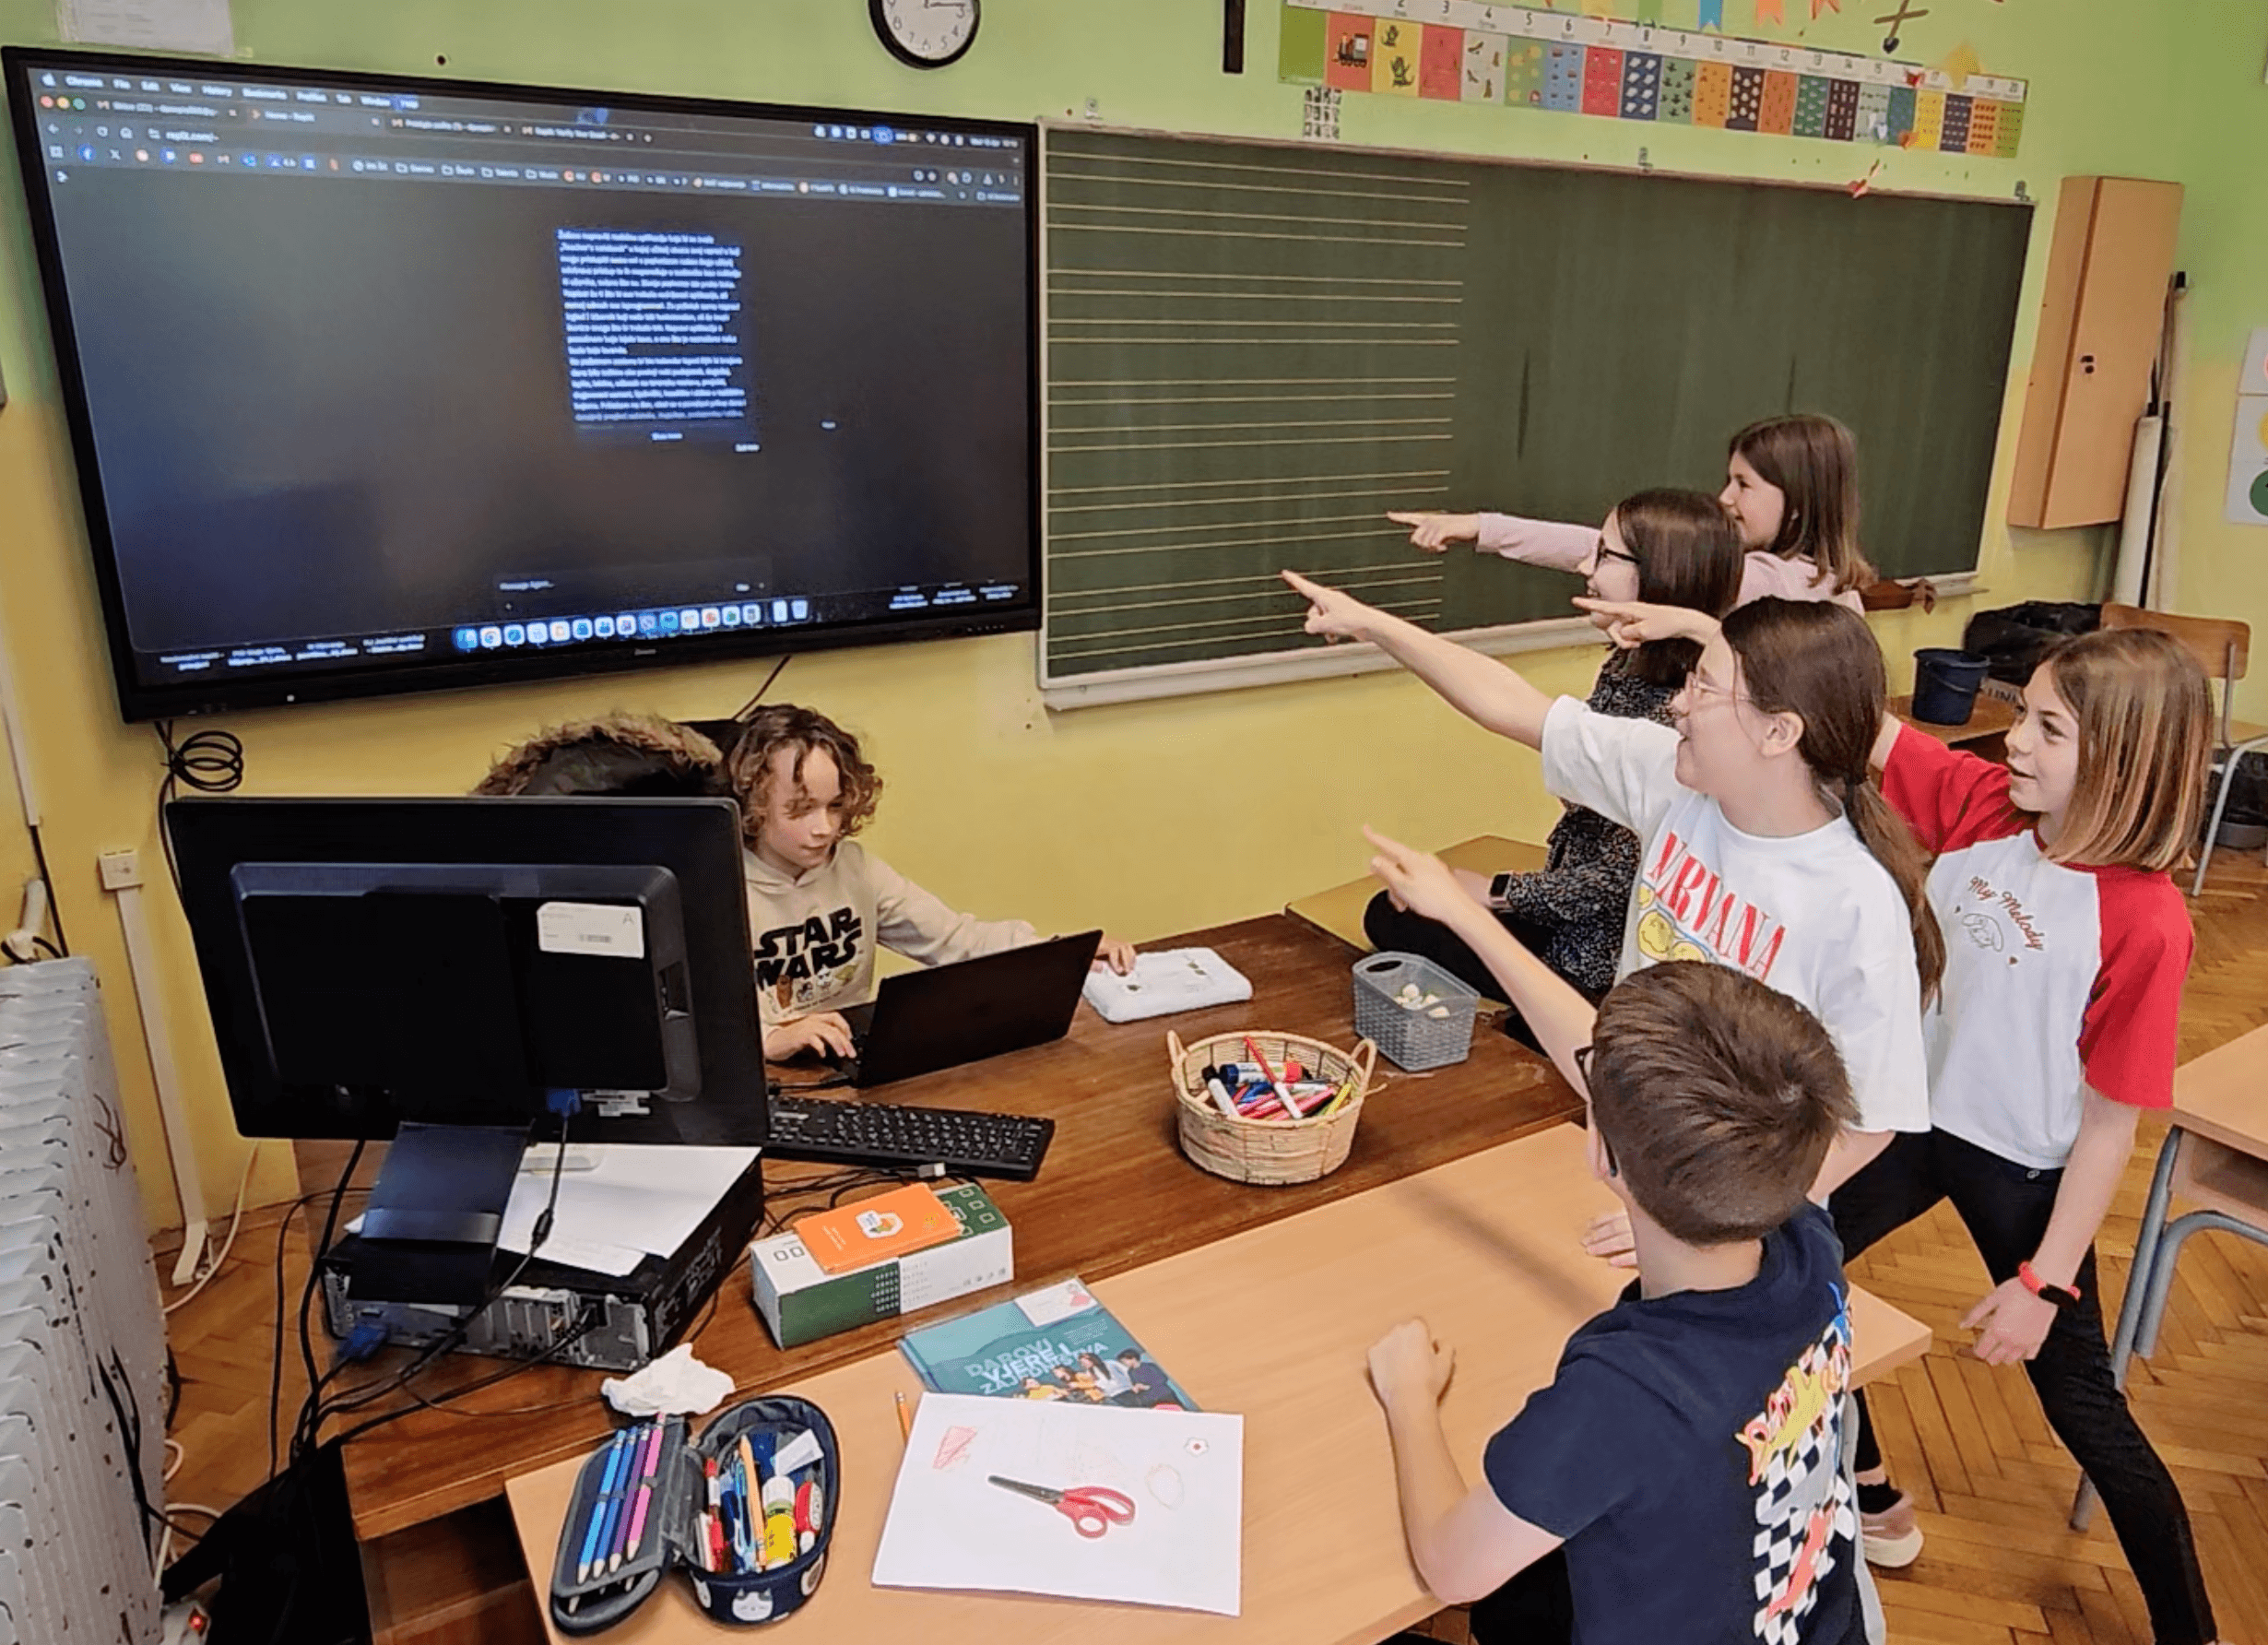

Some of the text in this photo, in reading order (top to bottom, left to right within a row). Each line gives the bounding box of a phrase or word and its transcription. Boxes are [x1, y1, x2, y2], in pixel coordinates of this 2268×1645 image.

[1442, 0, 1450, 15] 3
[1484, 7, 1492, 19] 4
[1525, 12, 1533, 26] 5
[1565, 18, 1572, 31] 6
[1605, 24, 1612, 36] 7
[1643, 30, 1650, 41] 8
[1680, 34, 1686, 46] 9
[1779, 49, 1790, 62] 12
[1647, 829, 1788, 983] NRVANA
[1967, 875, 2045, 951] My Melody
[754, 906, 862, 958] STAR
[757, 929, 862, 991] WARS
[963, 1337, 1054, 1378] DAROVI
[982, 1345, 1058, 1382] VJERE
